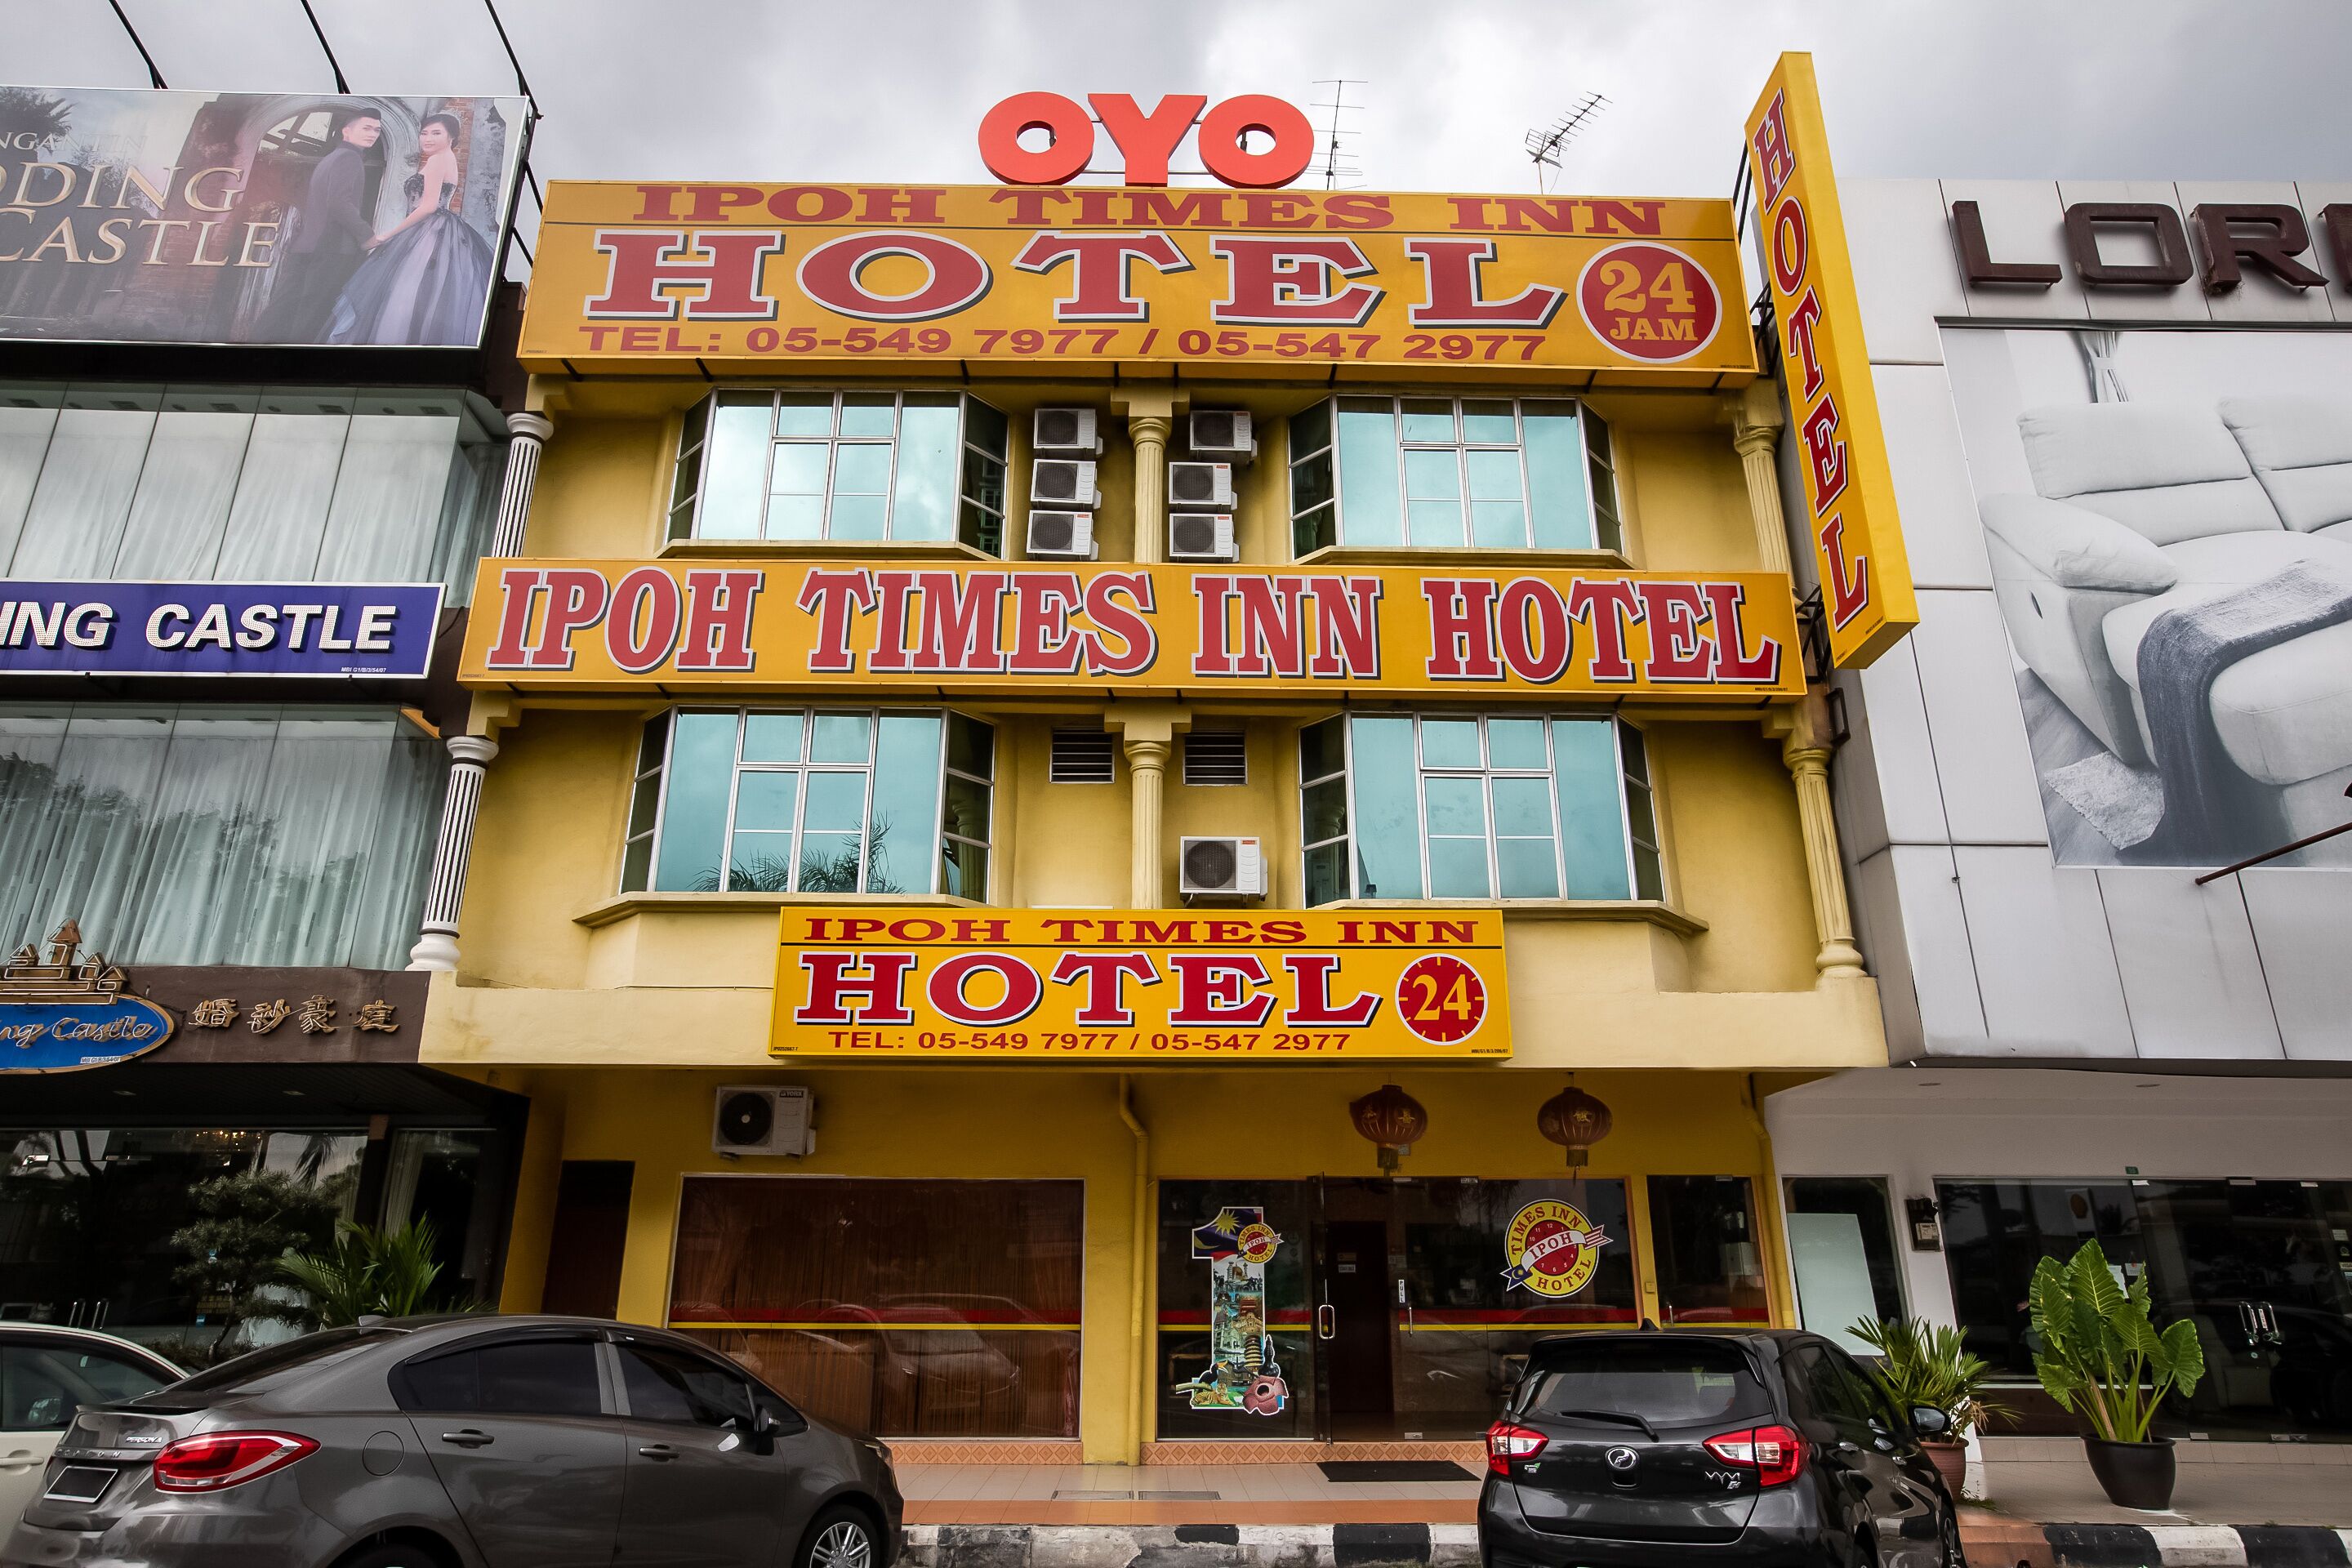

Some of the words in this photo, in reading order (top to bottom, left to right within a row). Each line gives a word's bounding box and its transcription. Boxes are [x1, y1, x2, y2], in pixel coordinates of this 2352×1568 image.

[978, 91, 1314, 189] OYO
[0, 162, 243, 212] DING
[632, 185, 947, 224] IPOH
[988, 189, 1395, 229] TIMES
[1447, 197, 1666, 236] INN
[1951, 200, 2352, 288] LOR
[583, 229, 1569, 328] HOTEL
[1599, 260, 1695, 314] 24
[579, 326, 721, 354] TEL:
[745, 327, 952, 354] 05-549
[973, 328, 1119, 354] 7977
[1178, 331, 1381, 359] 05-547
[1402, 334, 1547, 361] 2977
[1610, 318, 1698, 342] JAM
[1754, 87, 1869, 634] HOTEL
[145, 604, 400, 650] CASTLE
[486, 567, 765, 673] IPOH
[795, 567, 1158, 677] TIMES
[1191, 573, 1383, 679] INN
[1420, 576, 1781, 684] HOTEL
[804, 918, 1010, 942] IPOH
[1040, 919, 1307, 943] TIMES
[1337, 920, 1479, 943] INN
[794, 951, 1383, 1028] HOTEL
[1412, 974, 1472, 1021] 24
[52, 1016, 155, 1042] Castle
[828, 1032, 905, 1049] TEL:
[918, 1032, 1028, 1050] 05-549
[1040, 1033, 1120, 1050] 7977
[1151, 1033, 1260, 1051] 05-547
[1273, 1034, 1351, 1051] 2977
[1239, 1226, 1255, 1245] TIMES
[1247, 1237, 1266, 1248] IPOH
[1512, 1206, 1545, 1254] TIMES
[1552, 1205, 1582, 1228] INN
[1530, 1232, 1574, 1259] IPOH
[1249, 1249, 1272, 1261] HOTEL
[1536, 1258, 1592, 1291] HOTEL
